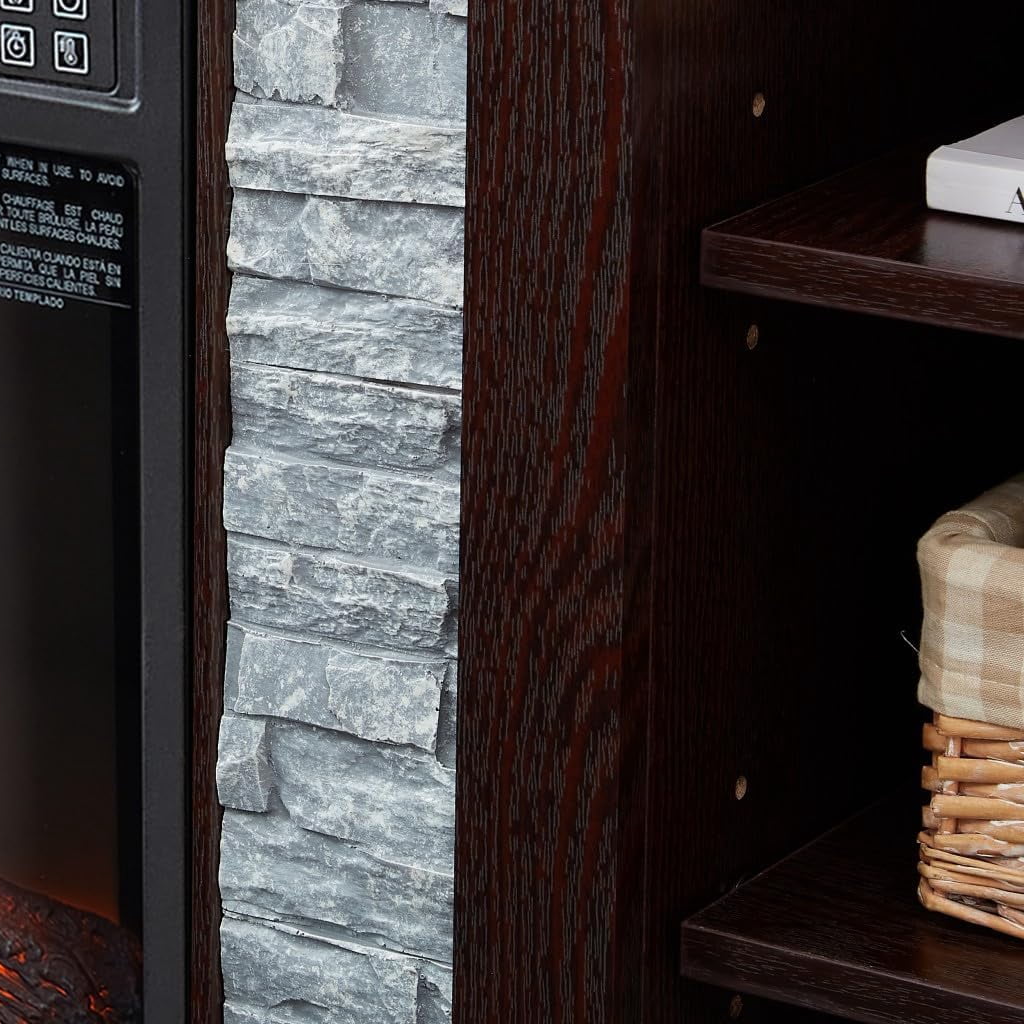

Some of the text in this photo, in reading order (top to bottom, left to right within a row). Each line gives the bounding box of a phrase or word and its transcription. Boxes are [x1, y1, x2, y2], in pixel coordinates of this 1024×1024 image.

[6, 156, 33, 170] WHEN
[38, 162, 48, 173] IN
[79, 169, 92, 181] TO
[96, 172, 124, 187] AVOID
[6, 206, 35, 221] TOUTE
[84, 221, 96, 232] LA
[98, 224, 123, 237] PEAU
[64, 204, 82, 217] EST
[91, 209, 123, 225] CHAUD
[10, 220, 27, 232] LES
[28, 223, 75, 241] SURFACES
[0, 243, 41, 260] CALIENTA
[42, 251, 80, 267] CUANDO
[82, 258, 105, 272] ESTÁ
[107, 263, 120, 275] EN
[38, 263, 57, 275] QUE
[63, 268, 75, 279] LA
[79, 271, 99, 283] PIEL
[105, 276, 120, 287] SIN
[14, 290, 64, 308] TEMPLADO
